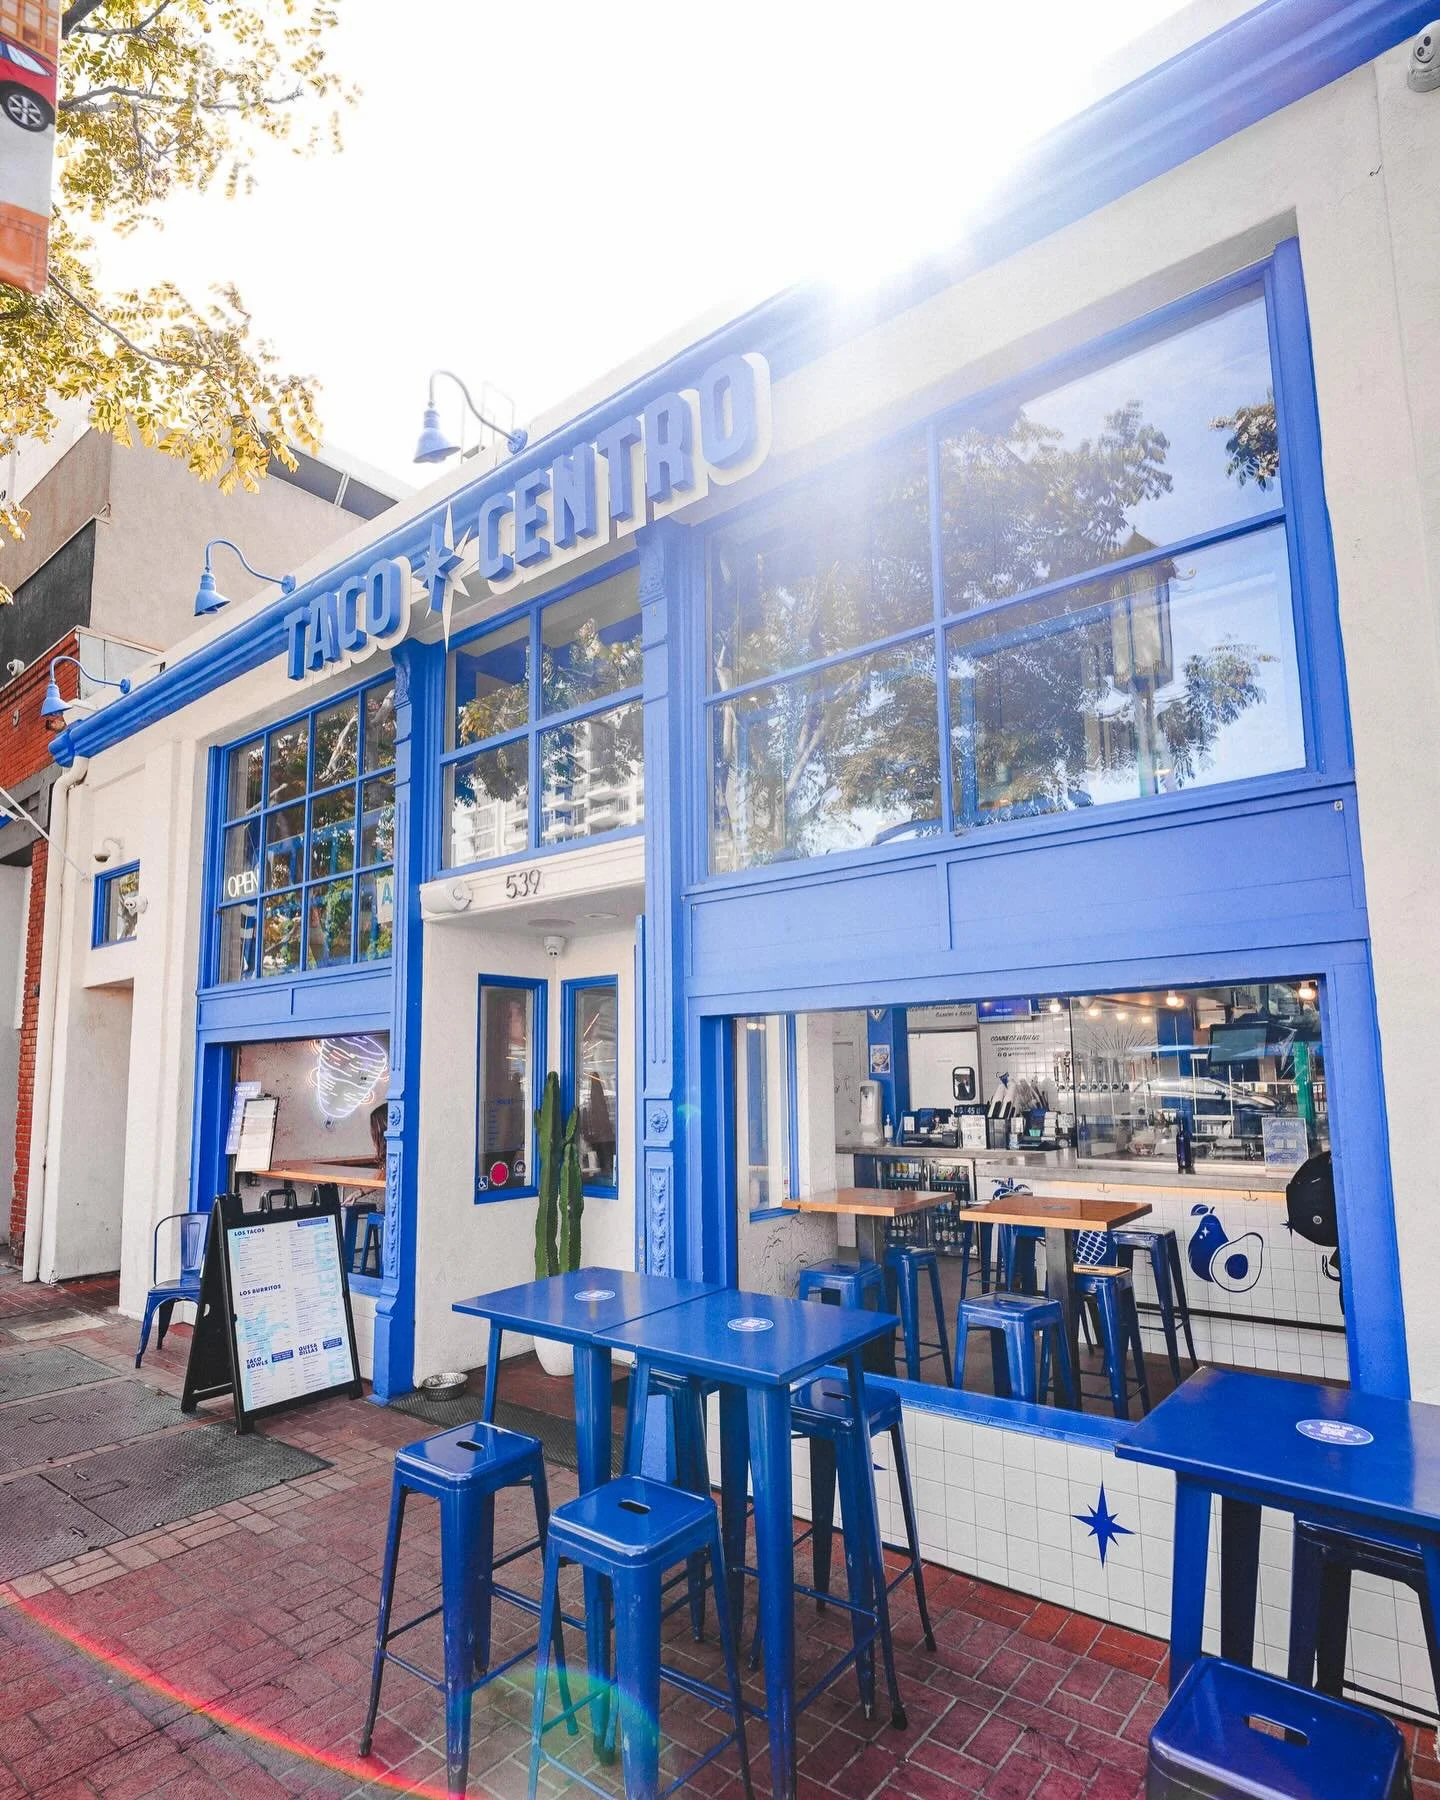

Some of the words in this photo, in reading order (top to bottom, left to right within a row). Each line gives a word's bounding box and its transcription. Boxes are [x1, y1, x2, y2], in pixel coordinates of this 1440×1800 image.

[284, 557, 405, 682] TACO
[478, 354, 762, 588] CENTRO
[228, 868, 260, 898] OPEN
[506, 869, 542, 899] 539
[381, 881, 393, 906] A
[247, 1227, 265, 1235] TACOS
[239, 1289, 251, 1297] LOS
[252, 1284, 281, 1294] BURRITOS
[246, 1356, 262, 1365] TACO
[247, 1360, 269, 1369] BOWLS
